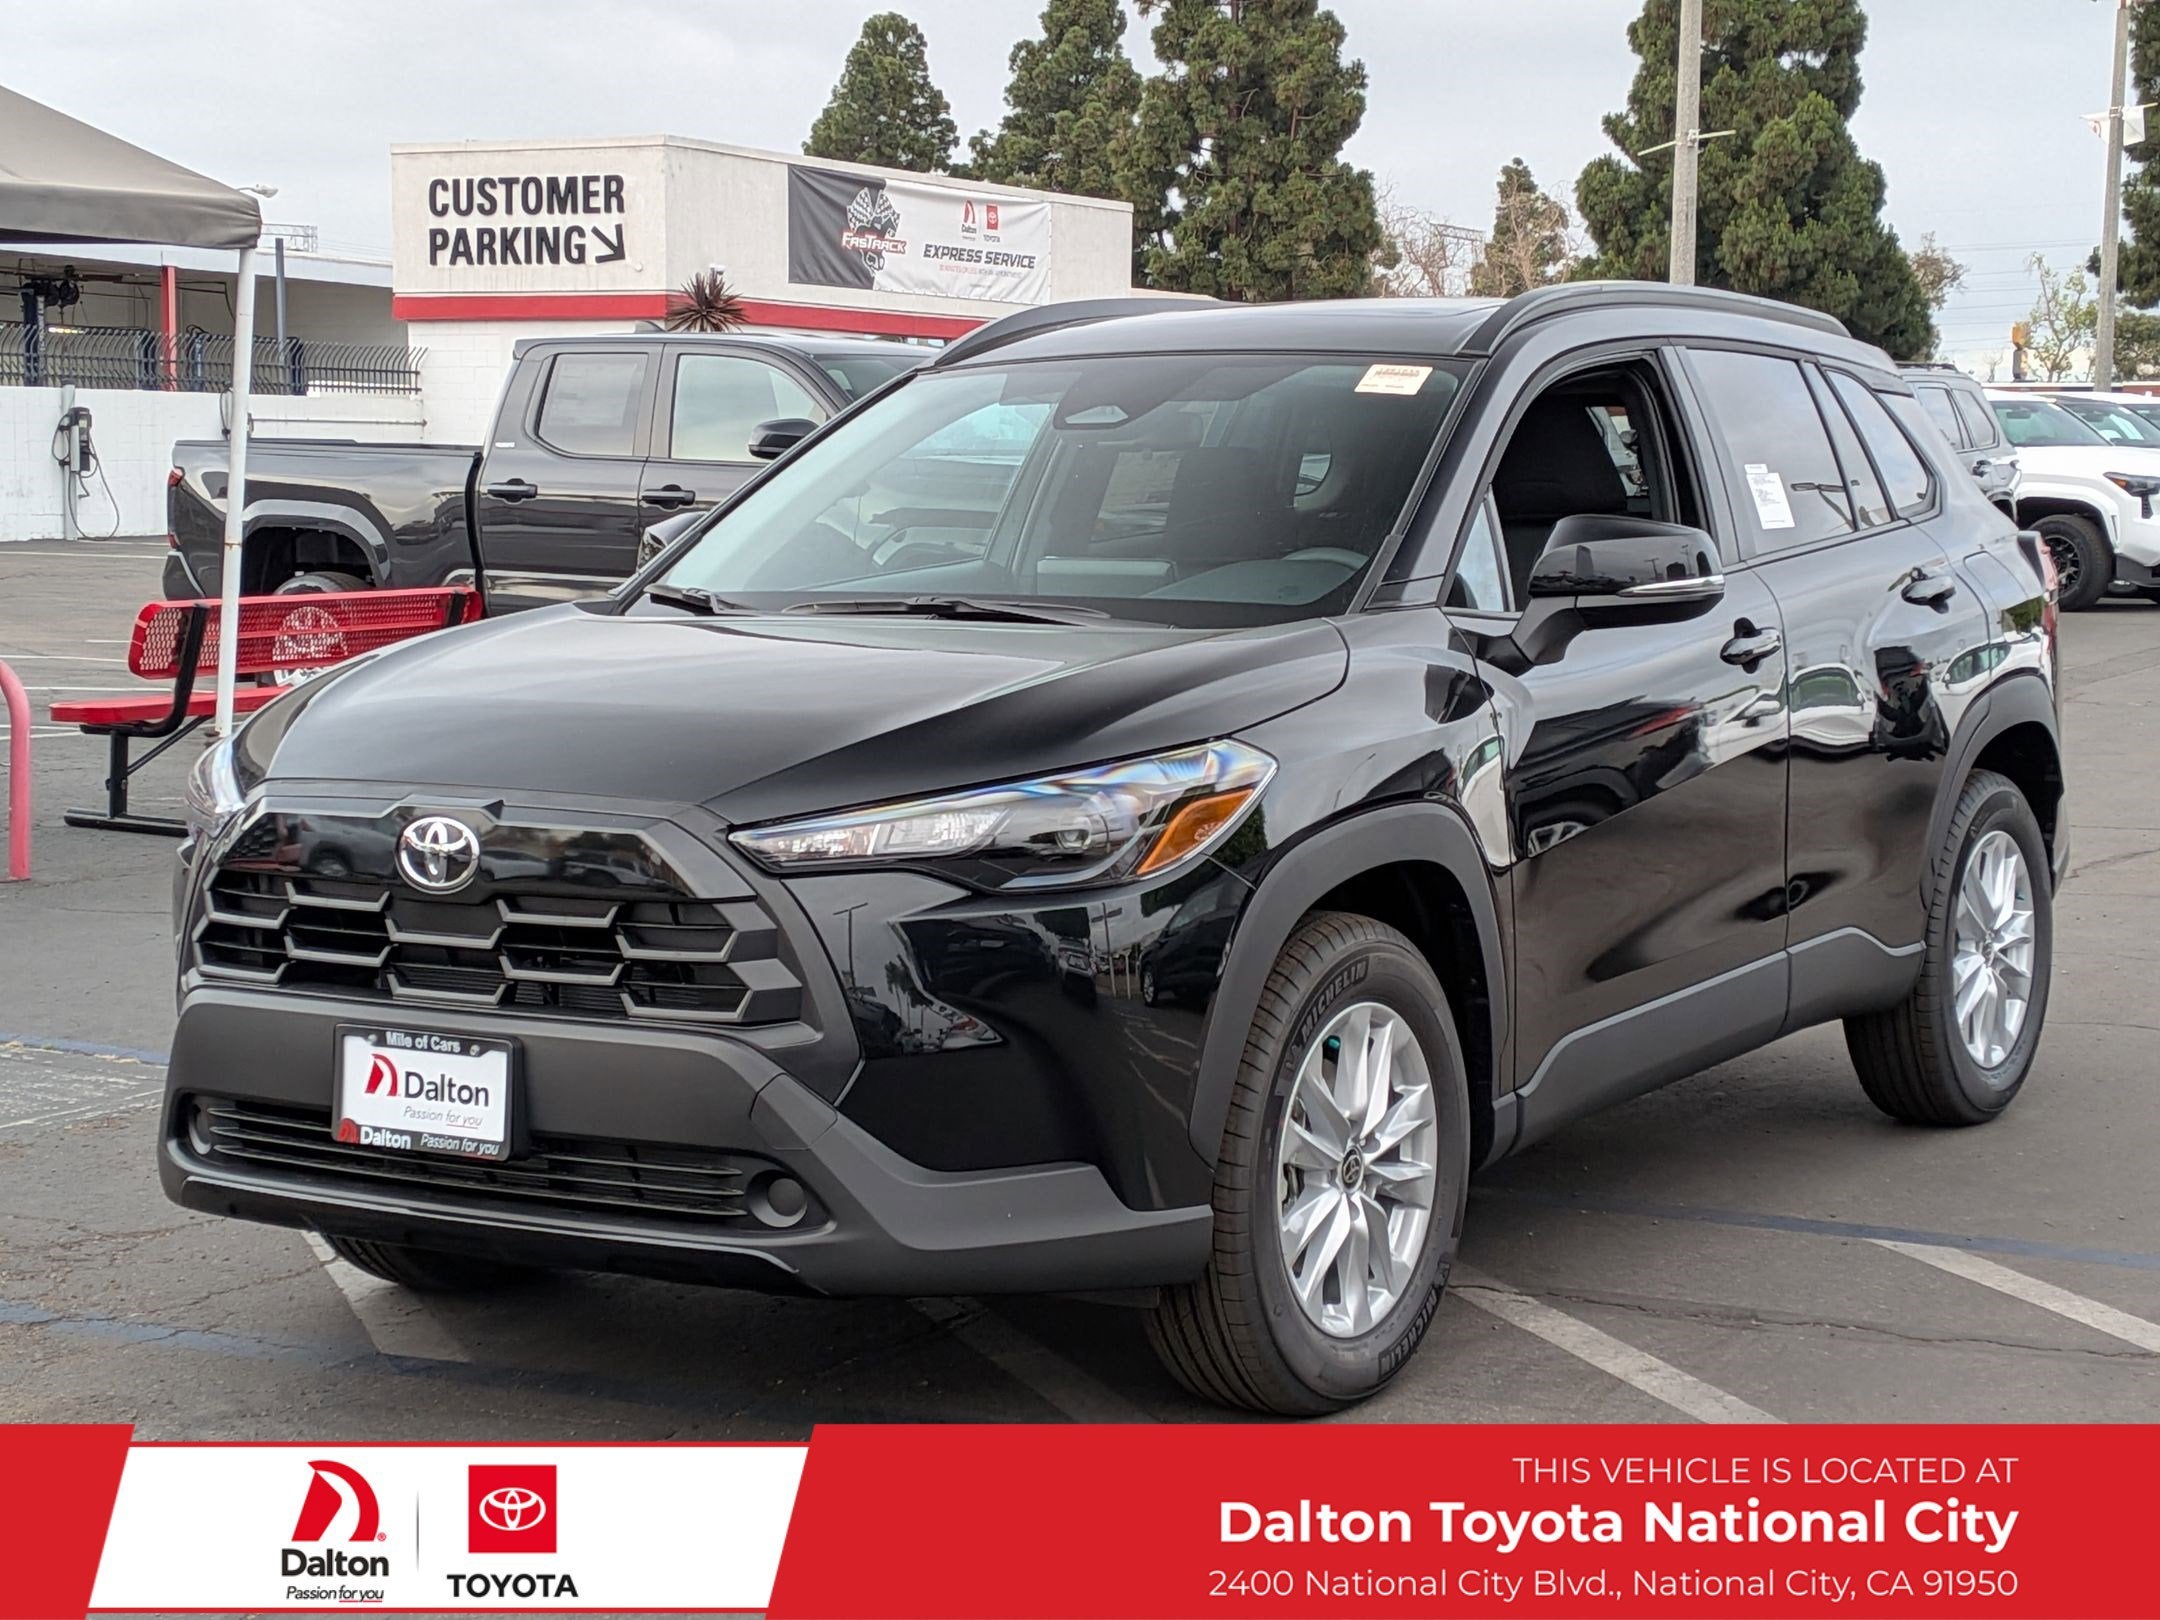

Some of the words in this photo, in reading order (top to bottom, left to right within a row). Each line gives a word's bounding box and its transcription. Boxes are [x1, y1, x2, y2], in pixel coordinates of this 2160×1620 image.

[429, 174, 625, 217] CUSTOMER
[429, 225, 586, 266] PARKING
[923, 243, 983, 264] EXPRESS
[984, 251, 1037, 270] SERVICE
[1301, 960, 1367, 1043] MICHELIN
[385, 1030, 412, 1048] Mile
[414, 1036, 429, 1050] of
[430, 1036, 461, 1053] Cars
[404, 1070, 490, 1107] Dalton
[403, 1105, 443, 1122] Passion
[445, 1110, 461, 1125] for
[463, 1115, 484, 1127] you
[360, 1126, 412, 1150] Dalton
[420, 1134, 460, 1152] Passion
[460, 1137, 477, 1153] for
[477, 1141, 501, 1156] you
